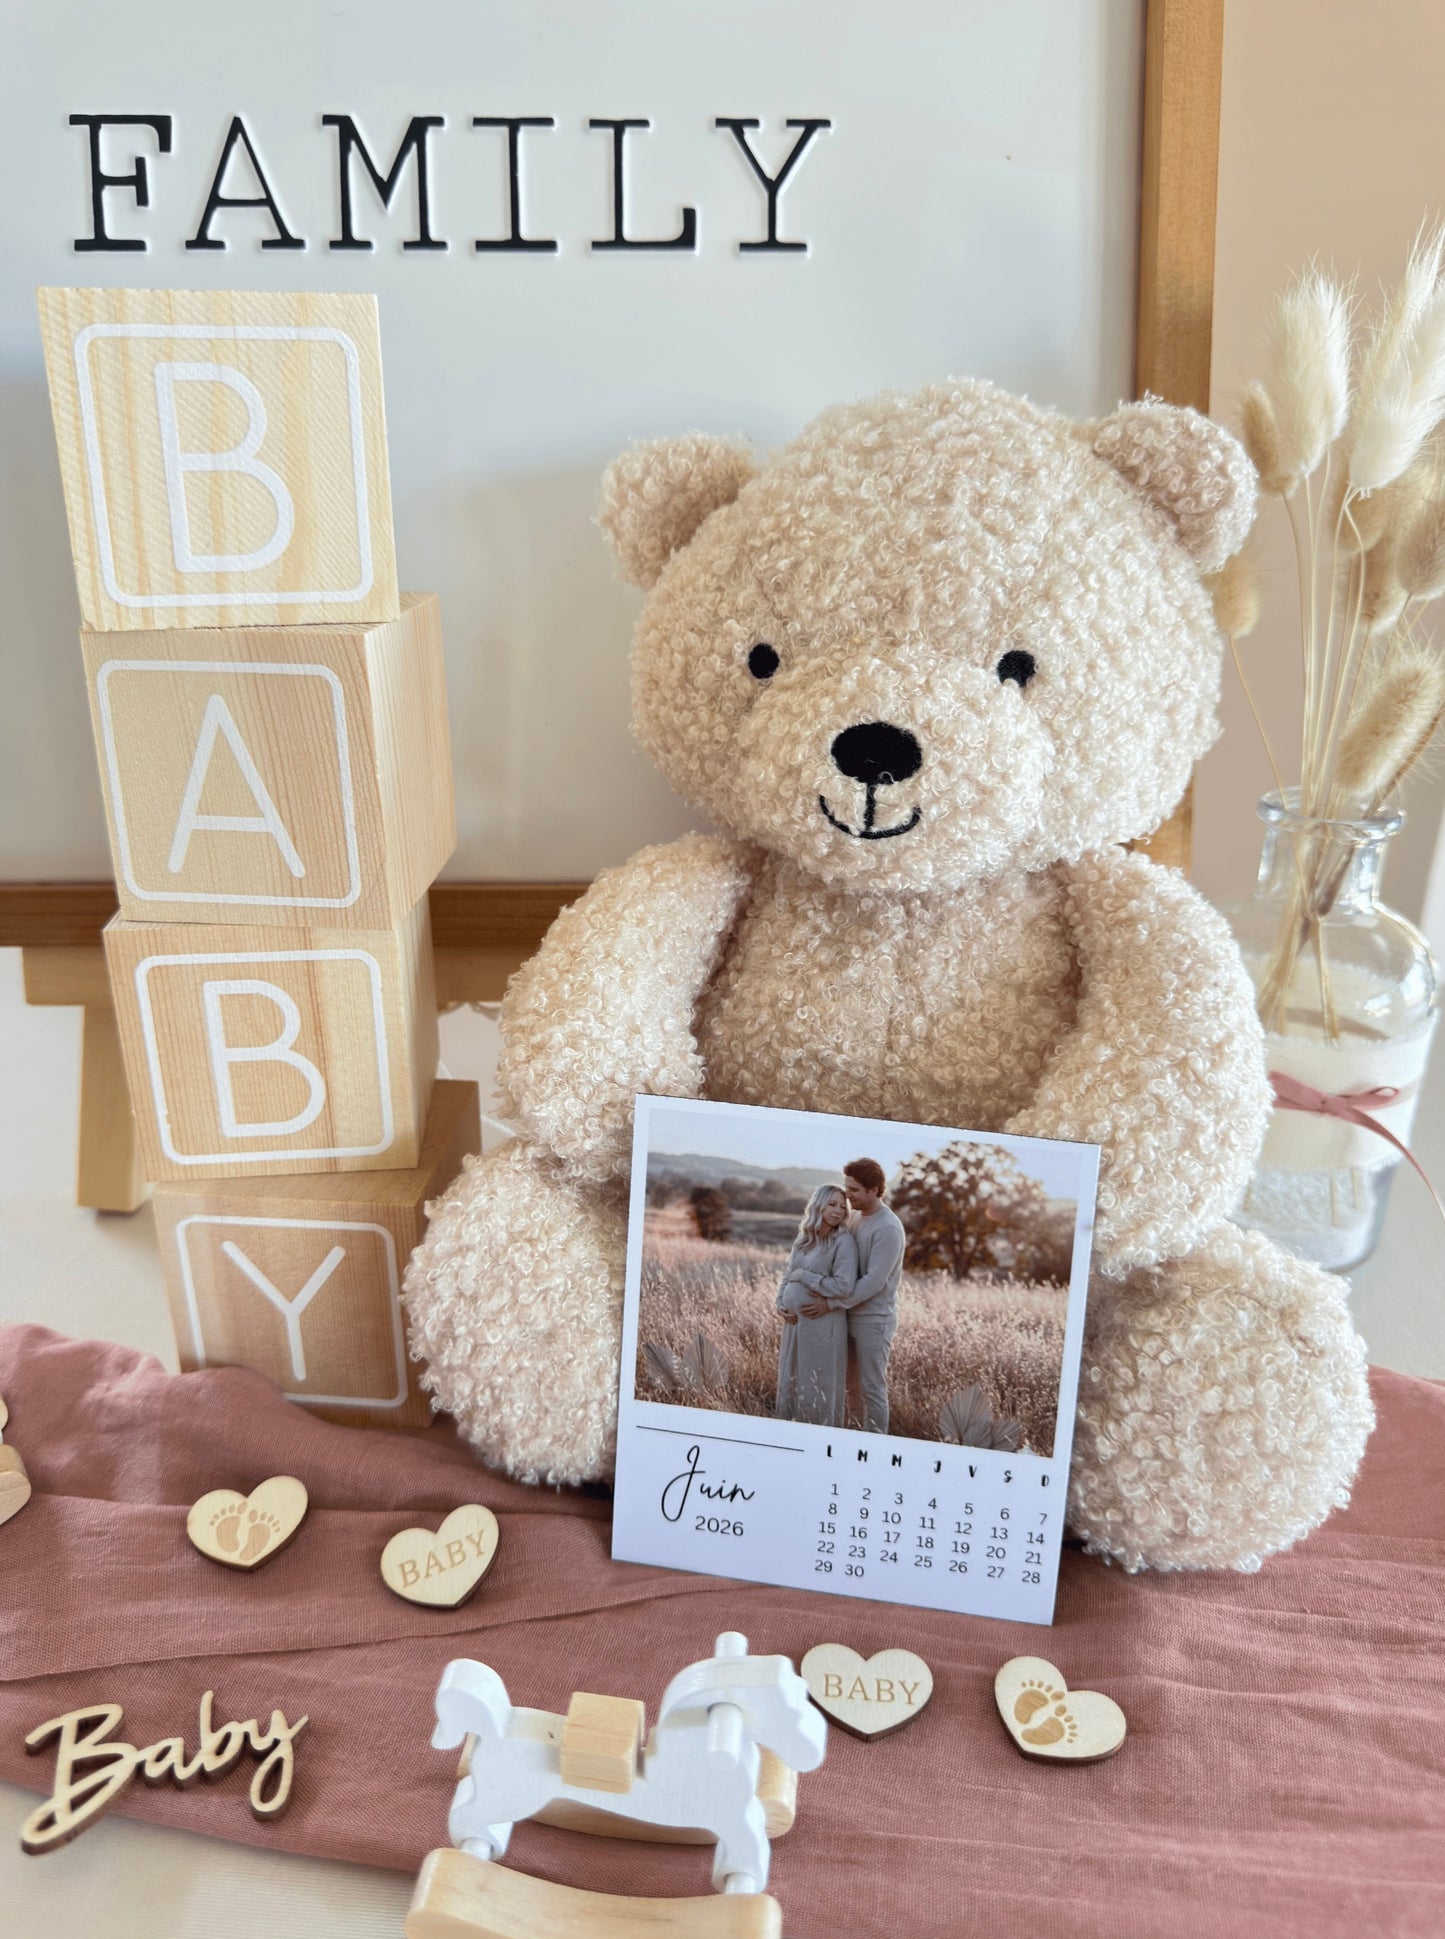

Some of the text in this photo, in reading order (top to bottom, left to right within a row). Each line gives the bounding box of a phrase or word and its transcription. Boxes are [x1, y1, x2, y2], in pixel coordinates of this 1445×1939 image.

[69, 114, 831, 252] FAMILY
[661, 1445, 755, 1522] Juin
[826, 1444, 833, 1458] L
[933, 1459, 943, 1474] J
[968, 1464, 978, 1479] V
[1003, 1469, 1014, 1484] S
[1040, 1474, 1050, 1488] D
[694, 1514, 745, 1537] 2026
[827, 1502, 1046, 1546] 8 9 10 11 12 13 14
[830, 1483, 1048, 1526] 1 2 3 4 5 6 7
[398, 1528, 486, 1588] BABY
[816, 1539, 1041, 1585] 22 23 24 25 26 27 28
[818, 1520, 1043, 1566] 15 16 17 18 19 20 21
[814, 1559, 865, 1578] 29 30
[823, 1673, 920, 1705] BABY
[22, 1690, 308, 1850] Baby
